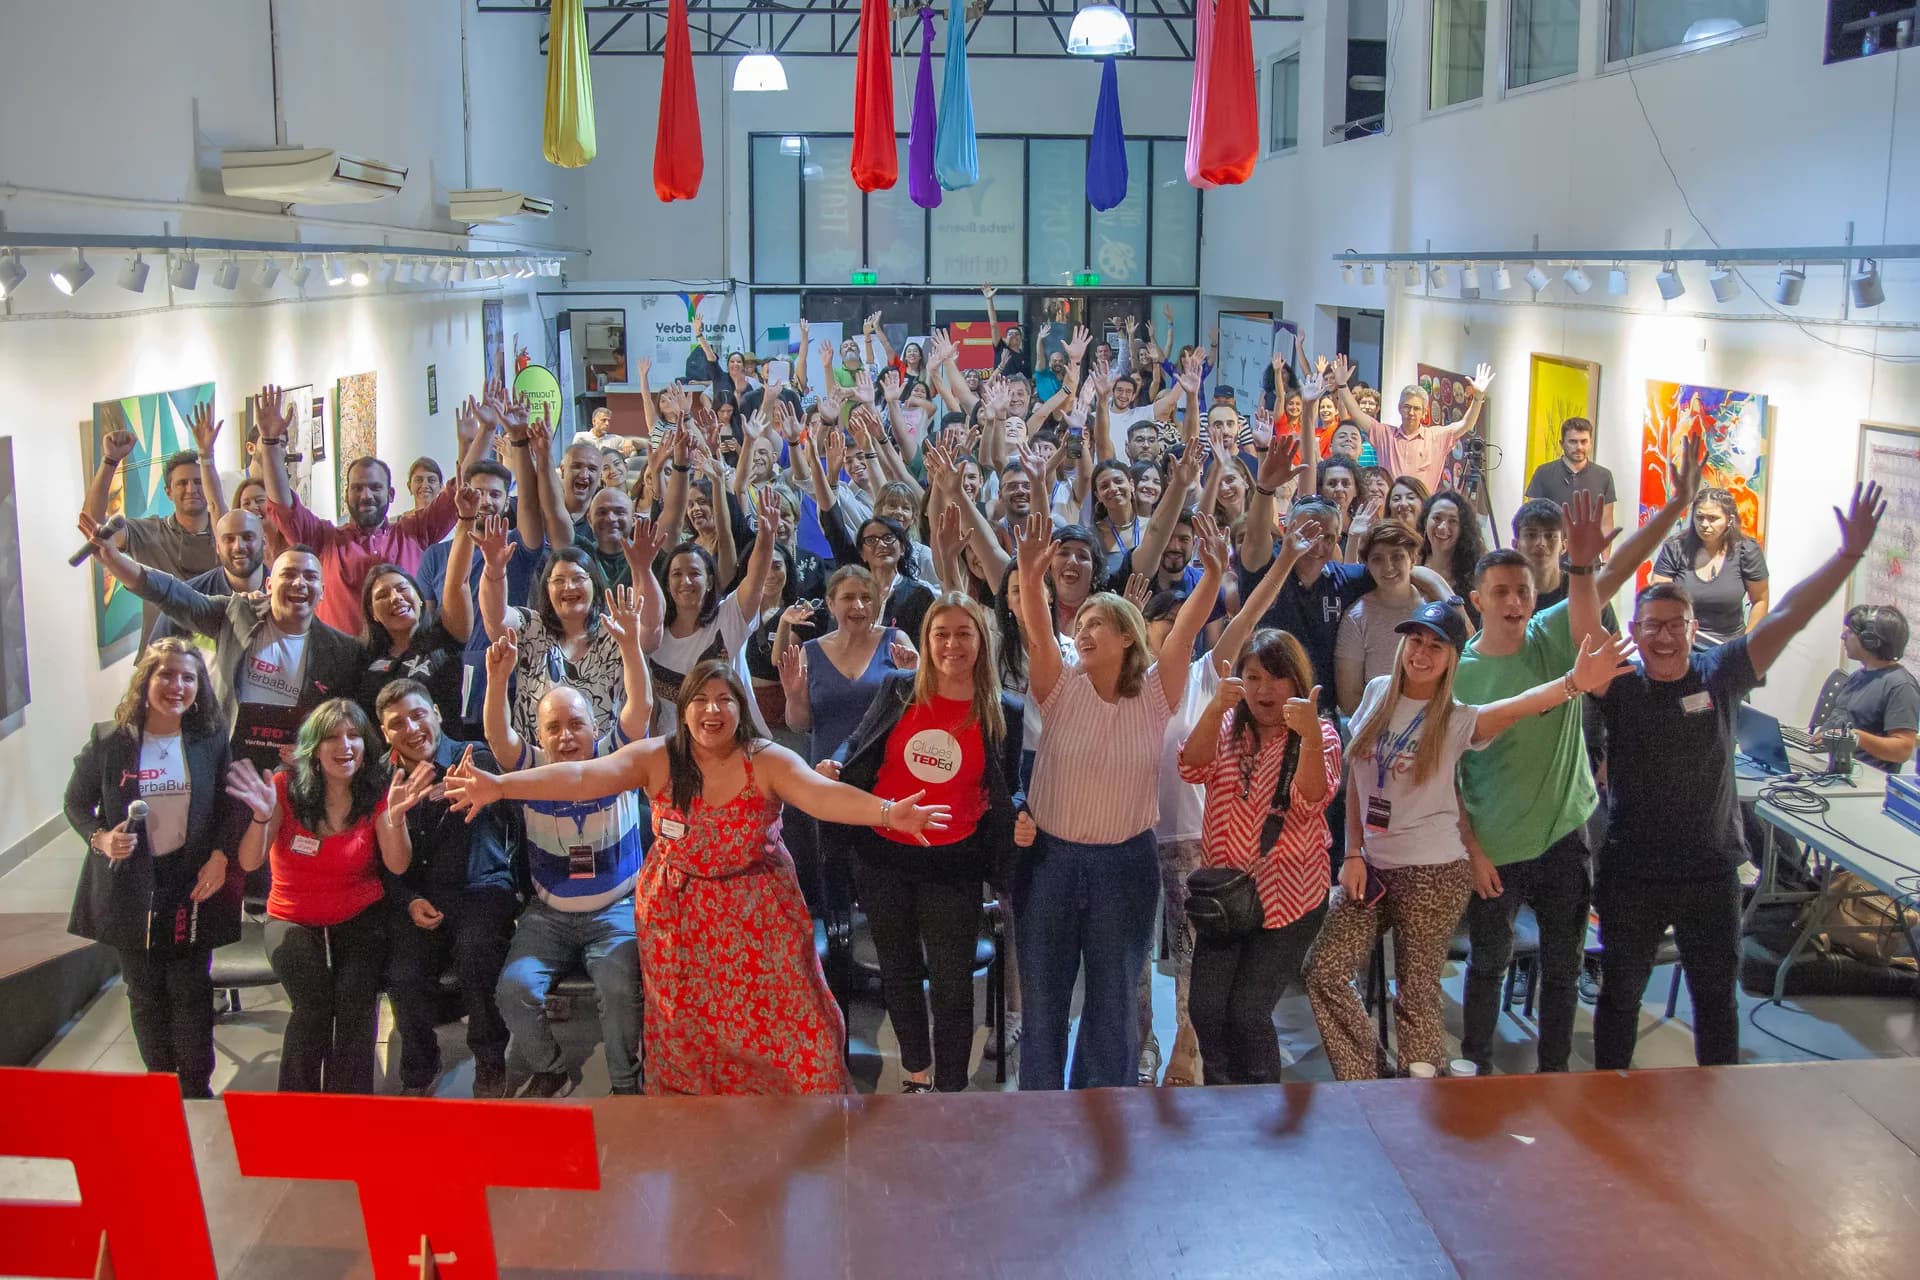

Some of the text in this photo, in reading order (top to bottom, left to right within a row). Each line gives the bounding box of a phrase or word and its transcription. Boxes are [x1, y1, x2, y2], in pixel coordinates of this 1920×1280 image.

[655, 322, 692, 333] Yerba
[1322, 595, 1342, 623] H
[912, 739, 953, 760] Clubes
[912, 752, 953, 772] TEDEd
[139, 768, 168, 781] EDx
[138, 779, 192, 794] erbaBue
